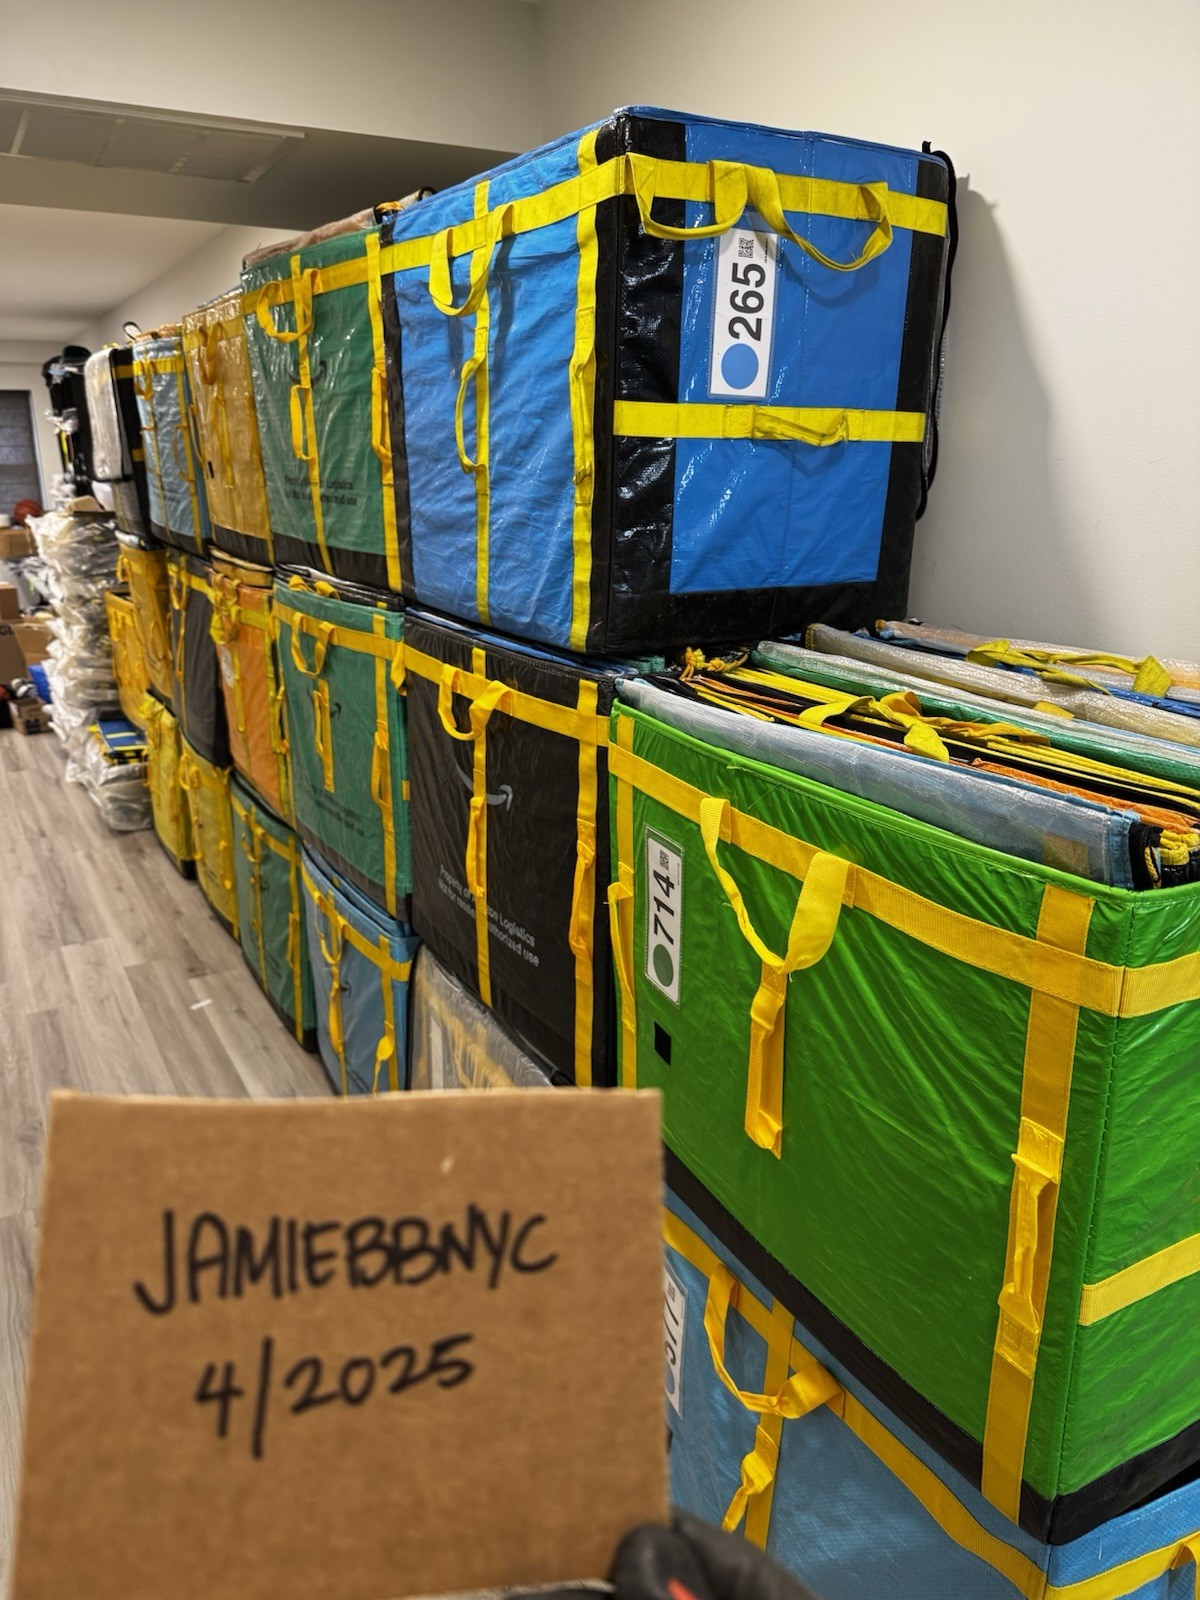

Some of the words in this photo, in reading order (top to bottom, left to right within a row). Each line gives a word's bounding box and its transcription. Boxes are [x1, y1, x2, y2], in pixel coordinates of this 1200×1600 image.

[728, 262, 766, 342] 265
[499, 912, 535, 947] Logistics
[653, 869, 675, 946] 714
[523, 948, 540, 967] use
[133, 1202, 558, 1317] JAMIEBBNYC
[194, 1332, 475, 1461] 4/2025
